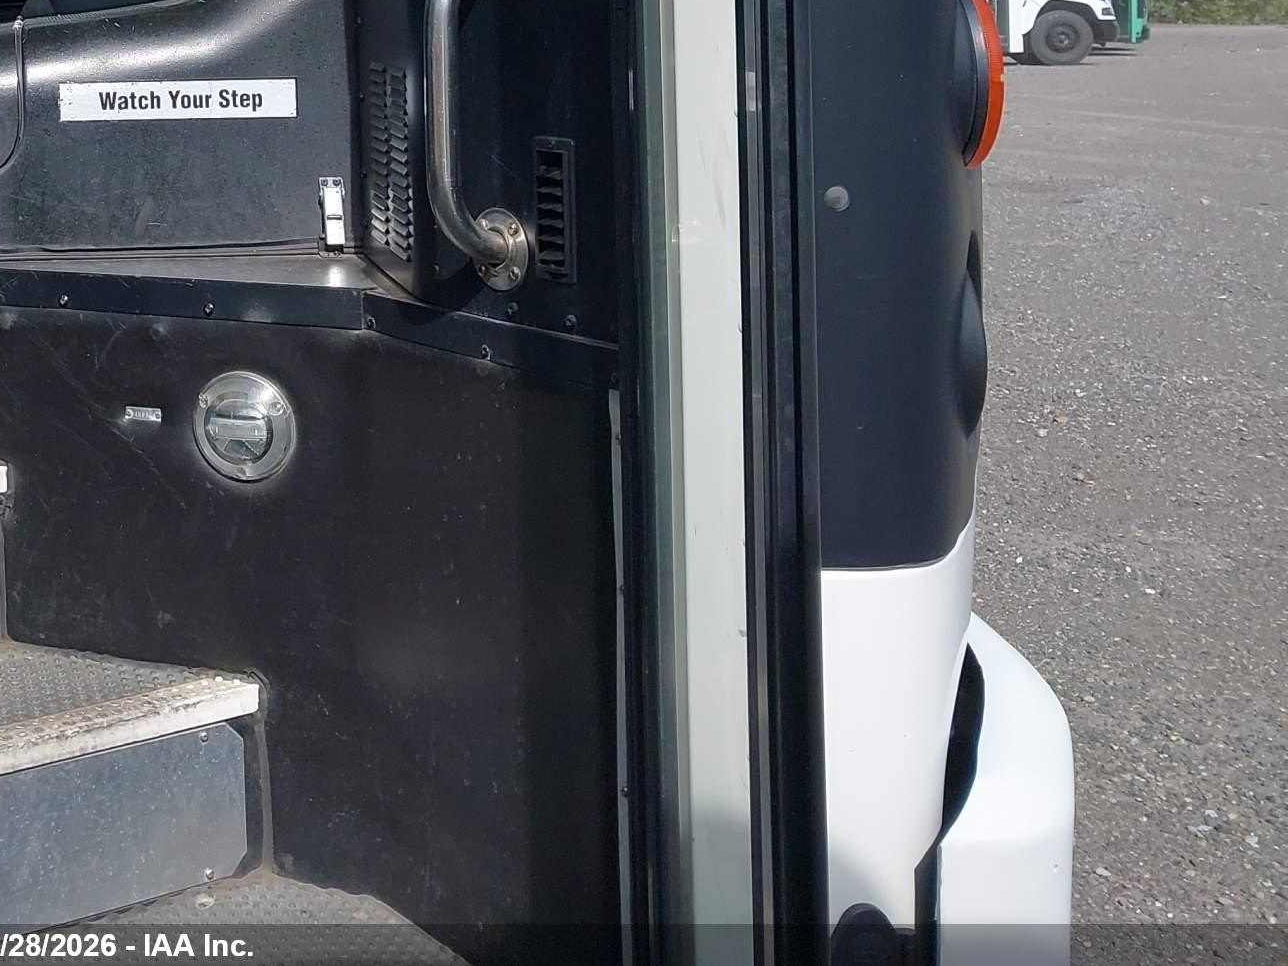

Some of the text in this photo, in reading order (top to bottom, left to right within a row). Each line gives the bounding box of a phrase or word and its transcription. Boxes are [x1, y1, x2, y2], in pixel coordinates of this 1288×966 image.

[98, 88, 263, 112] Watch Your Step
